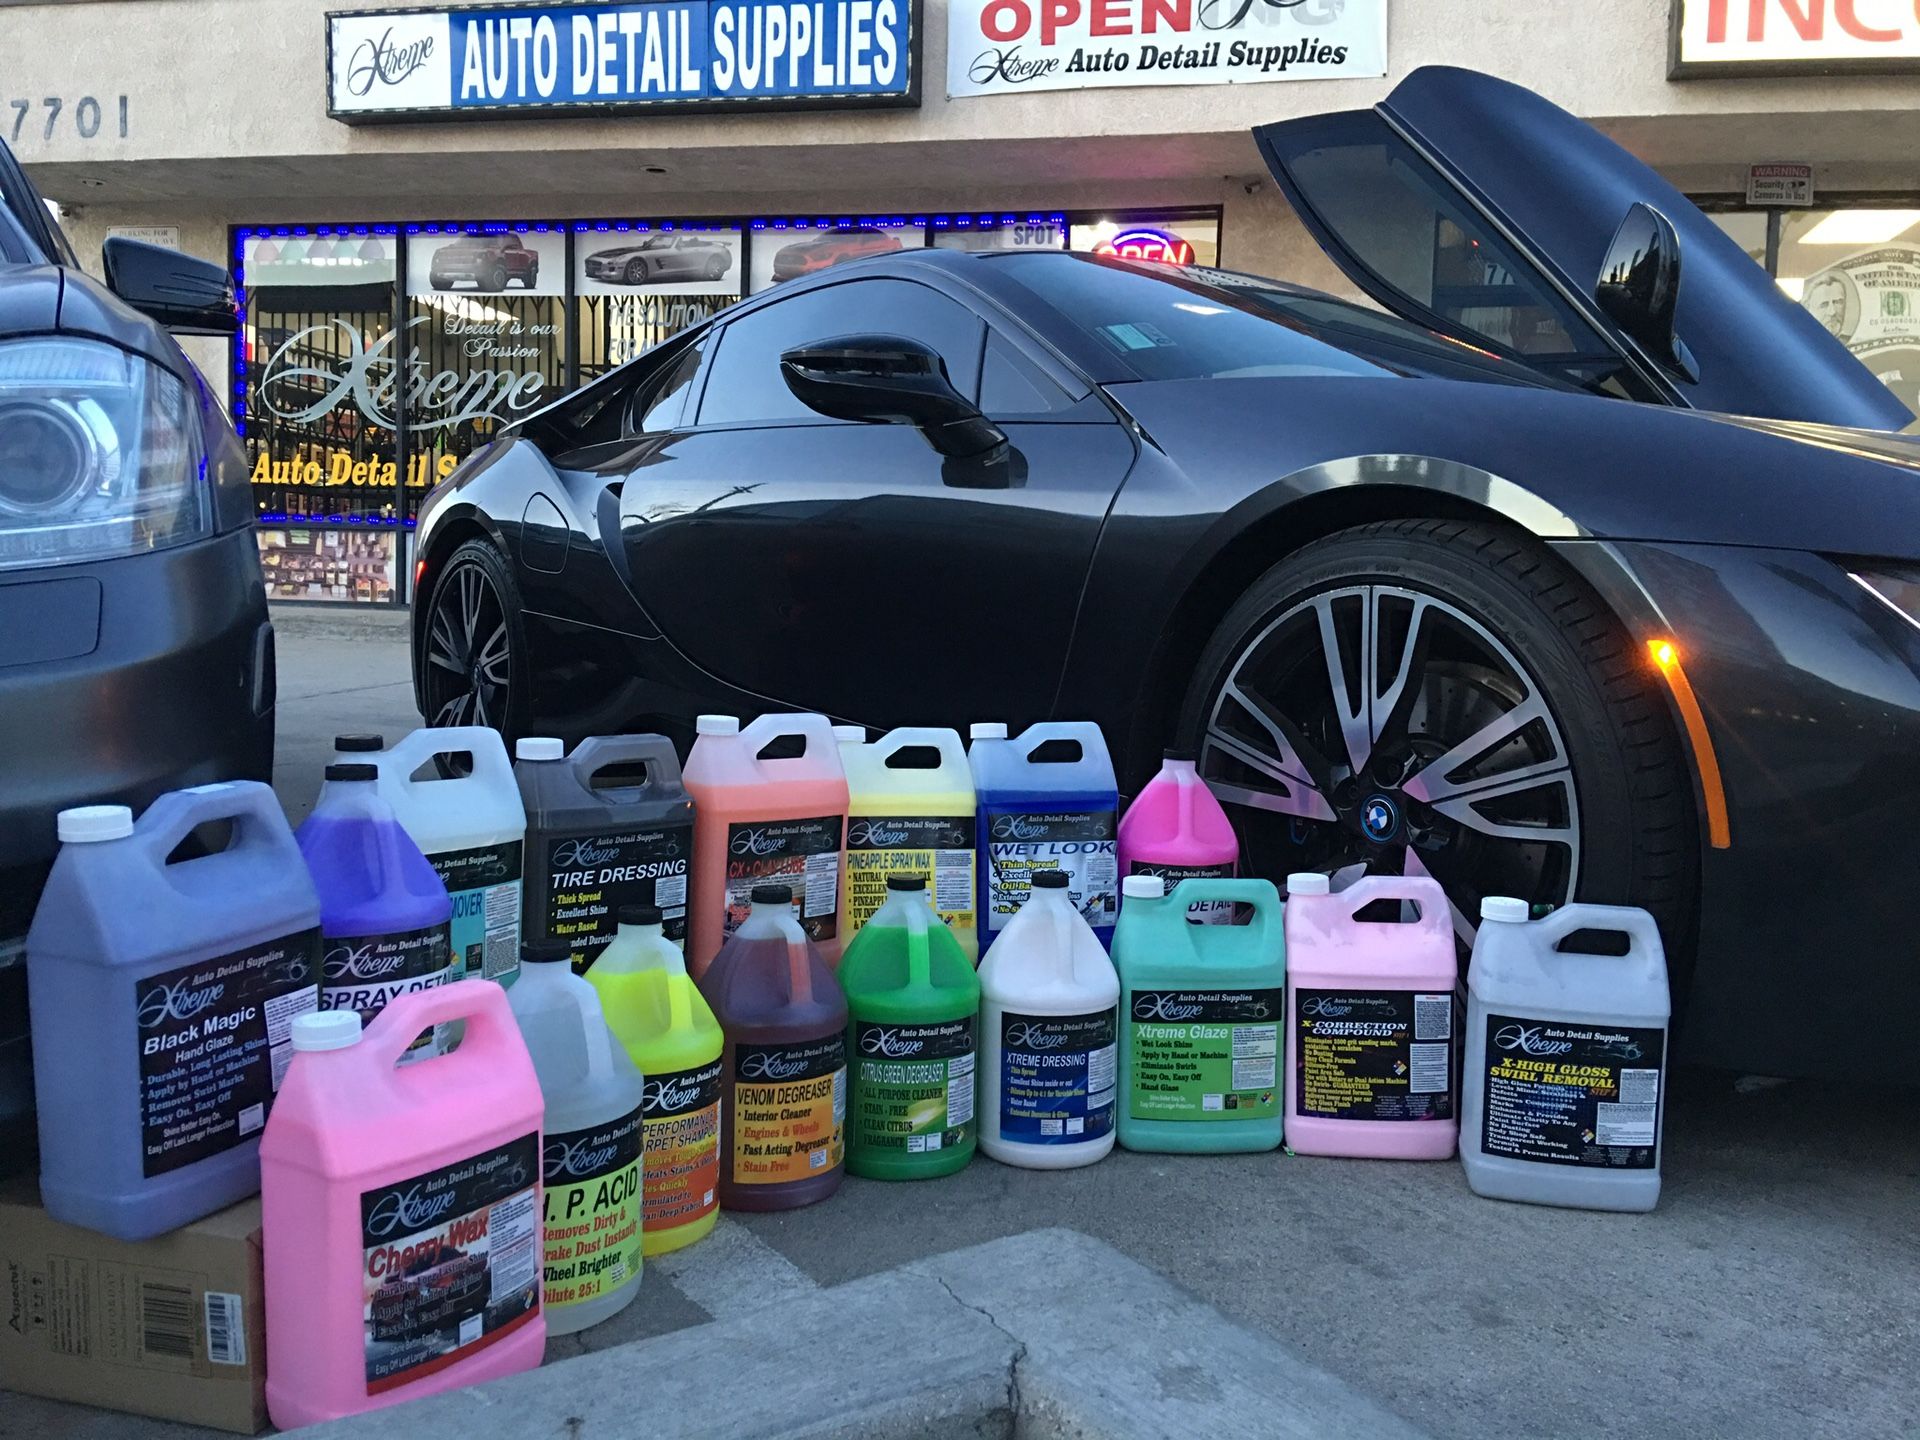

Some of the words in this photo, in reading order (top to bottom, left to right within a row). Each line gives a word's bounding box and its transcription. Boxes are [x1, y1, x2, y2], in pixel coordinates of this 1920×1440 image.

[347, 27, 434, 96] Xtreme
[461, 15, 557, 99] AUTO
[573, 9, 699, 95] DETAIL
[713, 0, 897, 91] SUPPLIES
[968, 45, 1059, 84] Xtreme
[1065, 48, 1129, 73] Auto
[1136, 42, 1218, 70] Detail
[1227, 38, 1348, 75] Supplies
[11, 96, 128, 141] 7701
[1755, 167, 1808, 177] WARNING
[1755, 180, 1784, 190] Security
[1754, 191, 1783, 200] Cameras
[1794, 191, 1805, 200] Use
[1014, 226, 1055, 246] SPOT
[1855, 271, 1894, 280] UNITED
[608, 305, 635, 327] THE
[638, 302, 708, 328] SOLUTION
[445, 314, 503, 336] Detail
[530, 322, 562, 336] our
[463, 337, 542, 358] Passion
[608, 339, 636, 360] FOR
[251, 453, 320, 485] Auto
[924, 821, 950, 829] Supplies
[1064, 814, 1090, 822] Supplies
[782, 825, 799, 835] Detail
[800, 824, 822, 834] Supplies
[596, 837, 613, 846] Auto
[615, 834, 635, 844] Detail
[637, 832, 664, 842] Supplies
[993, 843, 1047, 856] WET
[1050, 841, 1114, 855] LOOK
[444, 858, 466, 868] Detail
[468, 854, 498, 865] Supplies
[847, 853, 889, 869] PINEAPPLE
[890, 853, 915, 869] SPRAY
[915, 852, 931, 868] WAX
[1001, 860, 1025, 869] Thin
[1026, 859, 1058, 869] Spread
[552, 870, 596, 889] TIRE
[599, 859, 686, 884] DRESSING
[729, 861, 744, 878] CX
[853, 872, 882, 882] NATURAL
[450, 892, 482, 919] MOVER
[557, 894, 577, 905] Thick
[578, 891, 601, 904] Spread
[556, 908, 588, 919] Excellent
[589, 905, 608, 915] Shine
[556, 923, 576, 934] Water
[578, 920, 598, 931] Based
[376, 943, 396, 954] Auto
[398, 940, 421, 951] Detail
[192, 972, 215, 986] Auto
[217, 959, 244, 979] Detail
[247, 950, 285, 969] Supplies
[322, 944, 405, 979] Xtreme
[137, 976, 224, 1027] Xtreme
[319, 985, 401, 1011] SPRAY
[1178, 994, 1196, 1002] Auto
[1198, 994, 1220, 1002] Detail
[1222, 993, 1252, 1002] Supplies
[1133, 993, 1203, 1020] Xtreme
[144, 1025, 199, 1055] Black
[203, 1006, 256, 1036] Magic
[900, 1028, 917, 1038] Auto
[918, 1028, 939, 1036] Detail
[940, 1024, 963, 1036] Supplies
[1044, 1024, 1062, 1032] Auto
[1064, 1023, 1082, 1031] Detail
[1136, 1025, 1187, 1039] Xtreme
[1190, 1025, 1228, 1039] Glaze
[1302, 1020, 1407, 1030] X-CORRECTION
[1312, 1028, 1392, 1037] COMPOUND
[860, 1027, 923, 1056] Xtreme
[1006, 1022, 1068, 1050] Xtreme
[1155, 1040, 1172, 1048] Look
[1174, 1040, 1192, 1048] Shine
[1494, 1024, 1573, 1055] Xtreme
[1545, 1029, 1565, 1038] Auto
[1567, 1031, 1592, 1040] Detail
[1594, 1033, 1629, 1043] Supplies
[175, 1044, 204, 1063] Hand
[206, 1034, 234, 1053] Glaze
[786, 1052, 802, 1060] Auto
[804, 1048, 822, 1058] Detail
[1141, 1051, 1160, 1060] Apply
[1172, 1051, 1189, 1059] Hand
[1200, 1050, 1228, 1059] Machine
[1007, 1052, 1041, 1066] XTREME
[1042, 1054, 1086, 1067] DRESSING
[1141, 1062, 1174, 1070] Eliminate
[1501, 1057, 1556, 1074] X-HIGH
[1560, 1064, 1610, 1077] GLOSS
[860, 1062, 882, 1082] CITRUS
[883, 1064, 906, 1083] GREEN
[906, 1063, 944, 1084] DEGREASER
[1141, 1073, 1157, 1082] Easy
[1173, 1073, 1189, 1082] Easy
[1490, 1066, 1538, 1082] SWIRL
[1542, 1074, 1615, 1089] REMOVAL
[148, 1084, 176, 1100] Apply
[149, 1095, 192, 1113] Removes
[219, 1073, 245, 1089] Marks
[738, 1086, 775, 1106] VENOM
[778, 1078, 832, 1104] DEGREASER
[864, 1088, 877, 1098] ALL
[878, 1088, 910, 1098] PURPOSE
[912, 1088, 943, 1100] CLEANER
[1141, 1084, 1158, 1092] Hand
[1159, 1084, 1179, 1092] Glaze
[744, 1111, 778, 1122] Interior
[780, 1107, 812, 1120] Cleaner
[864, 1104, 884, 1115] STAIN
[889, 1105, 908, 1116] FREE
[744, 1127, 780, 1139] Engines
[792, 1121, 819, 1136] Wheels
[864, 1120, 886, 1132] CLEAN
[887, 1121, 913, 1132] CITRUS
[591, 1134, 611, 1147] Auto
[613, 1125, 631, 1140] Detail
[743, 1145, 763, 1156] Fast
[765, 1142, 793, 1156] Acting
[795, 1135, 830, 1154] Degreaser
[425, 1176, 447, 1193] Auto
[449, 1164, 474, 1185] Detail
[476, 1153, 509, 1175] Supplies
[743, 1161, 768, 1173] Stain
[770, 1161, 789, 1171] Free
[566, 1187, 585, 1219] P.
[592, 1166, 638, 1213] ACID
[660, 1178, 688, 1191] Quickly
[366, 1183, 455, 1236] Xtreme
[593, 1211, 617, 1231] Dirty
[368, 1233, 444, 1279] Cherry
[450, 1214, 489, 1250] Wax
[575, 1239, 601, 1258] Dust
[604, 1219, 638, 1248] Instantly
[579, 1251, 622, 1275] Brighter
[579, 1279, 601, 1297] 25:1
